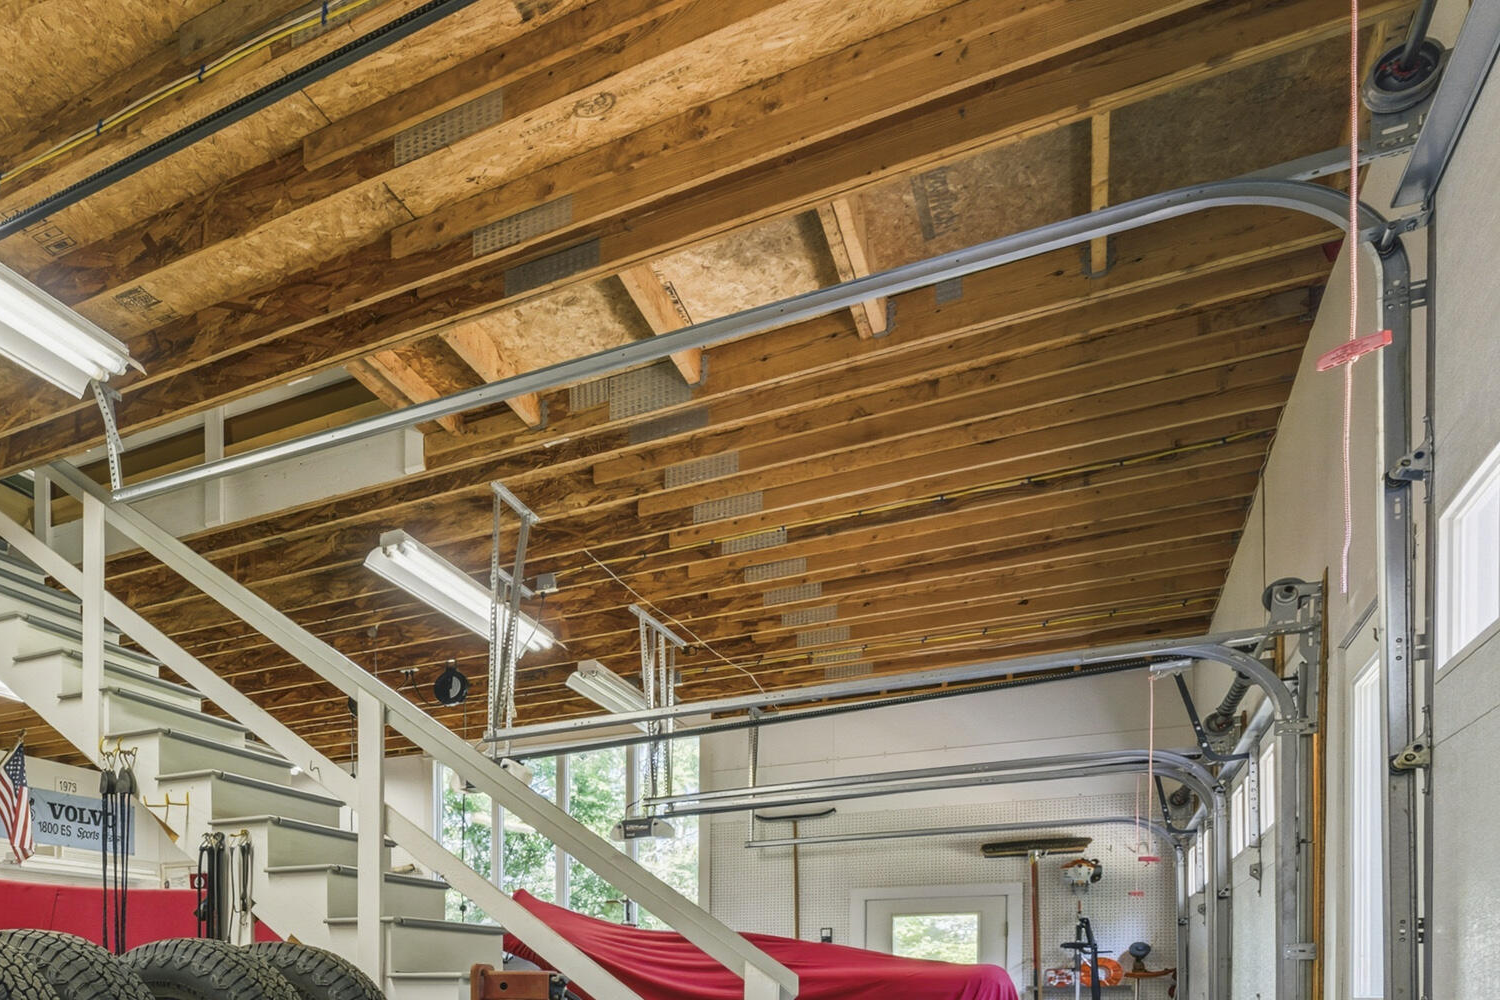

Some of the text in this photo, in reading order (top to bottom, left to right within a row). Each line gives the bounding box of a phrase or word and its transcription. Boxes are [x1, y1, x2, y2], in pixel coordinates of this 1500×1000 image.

[59, 780, 77, 793] 1973
[38, 821, 59, 835] 1800
[60, 825, 72, 837] ES
[76, 827, 100, 841] Sports
